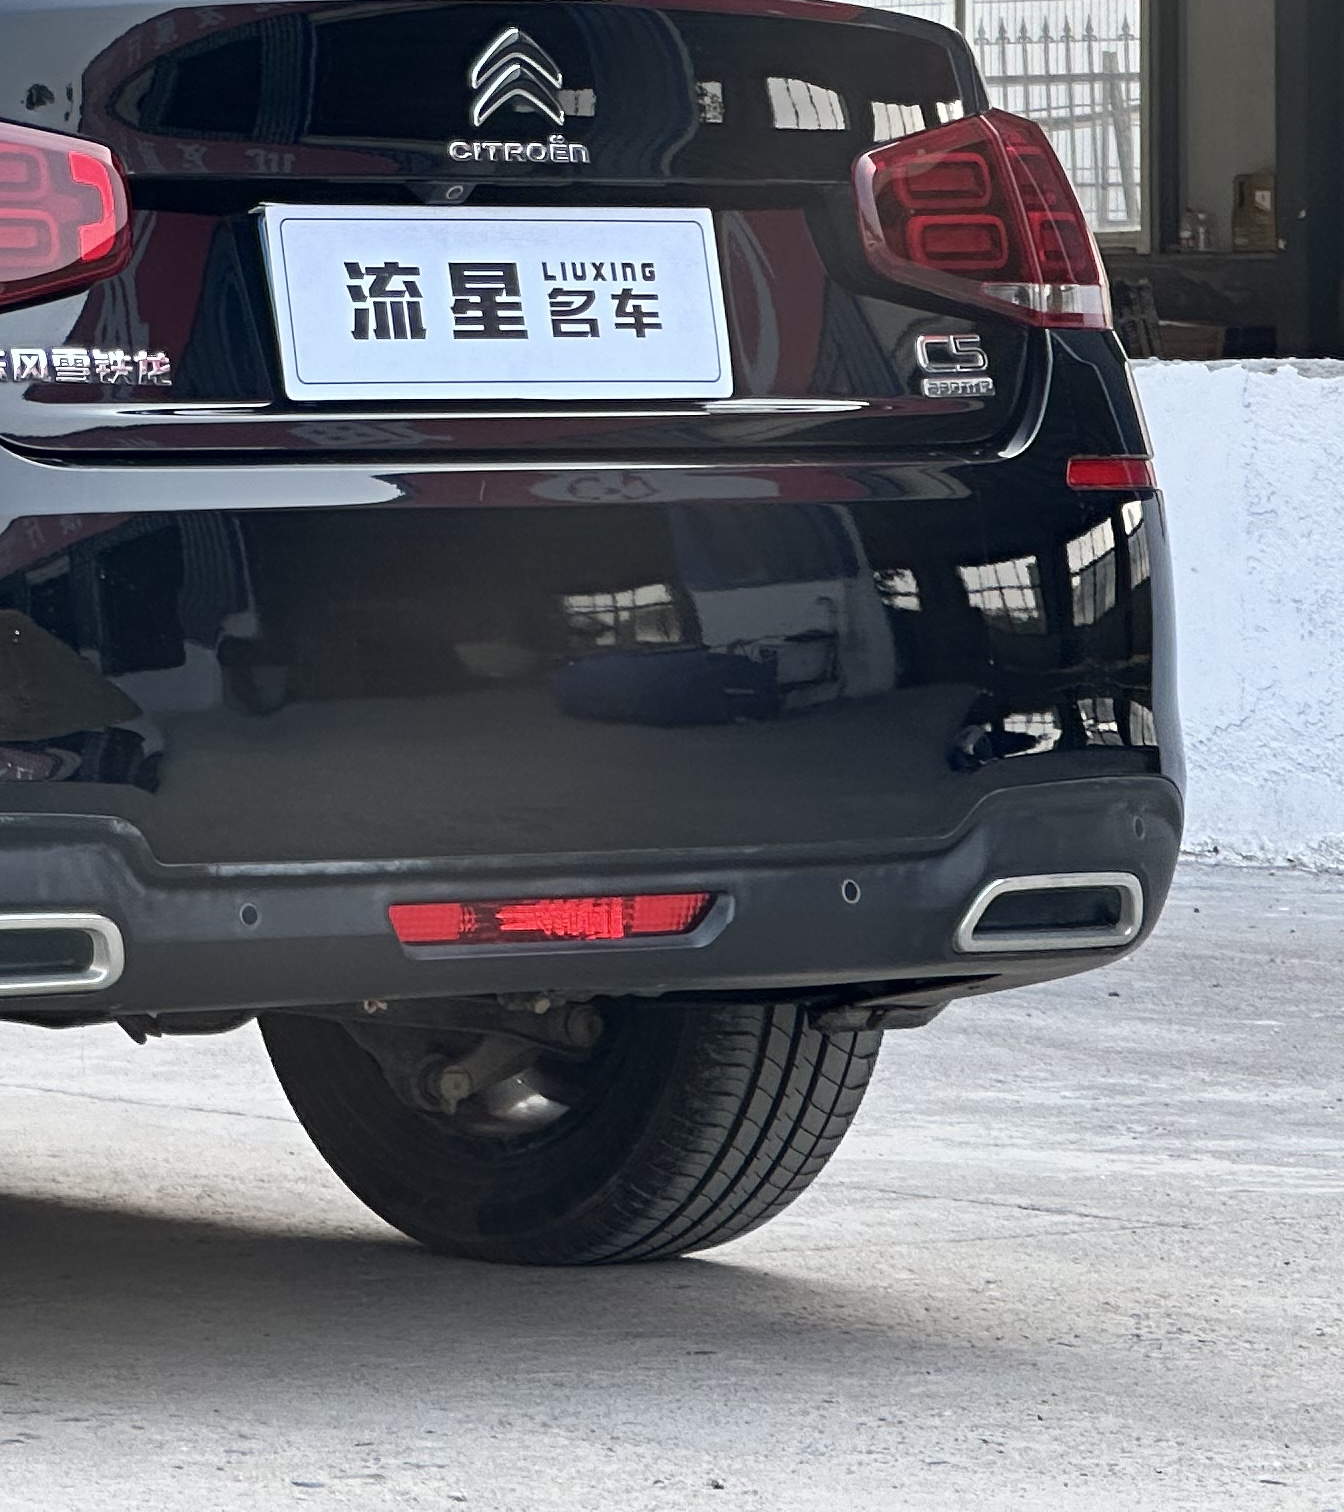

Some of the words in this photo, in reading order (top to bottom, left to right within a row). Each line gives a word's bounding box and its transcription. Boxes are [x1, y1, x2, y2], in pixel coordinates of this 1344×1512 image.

[345, 261, 526, 341] 流星
[548, 288, 664, 339] 名车
[916, 334, 989, 373] C5
